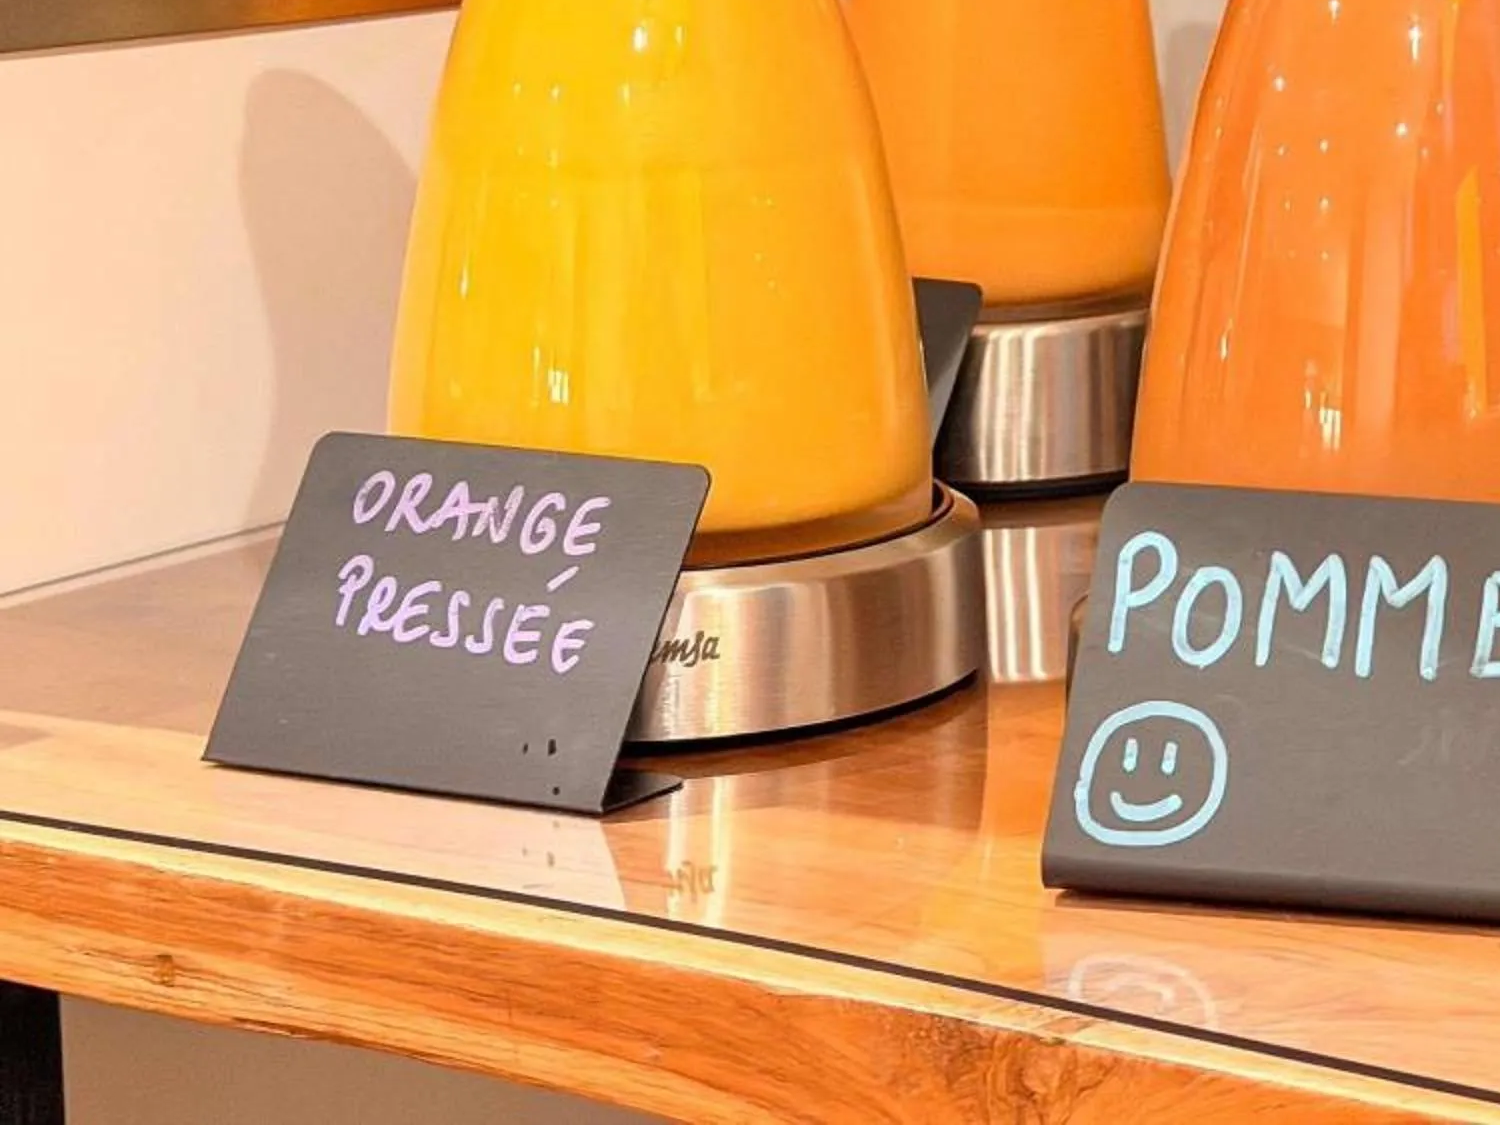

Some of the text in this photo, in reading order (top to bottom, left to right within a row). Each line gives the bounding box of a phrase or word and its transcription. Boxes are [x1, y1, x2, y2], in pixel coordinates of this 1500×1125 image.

[352, 469, 611, 557] ORANGE
[334, 553, 596, 674] PRESSÉE
[651, 630, 721, 668] msa
